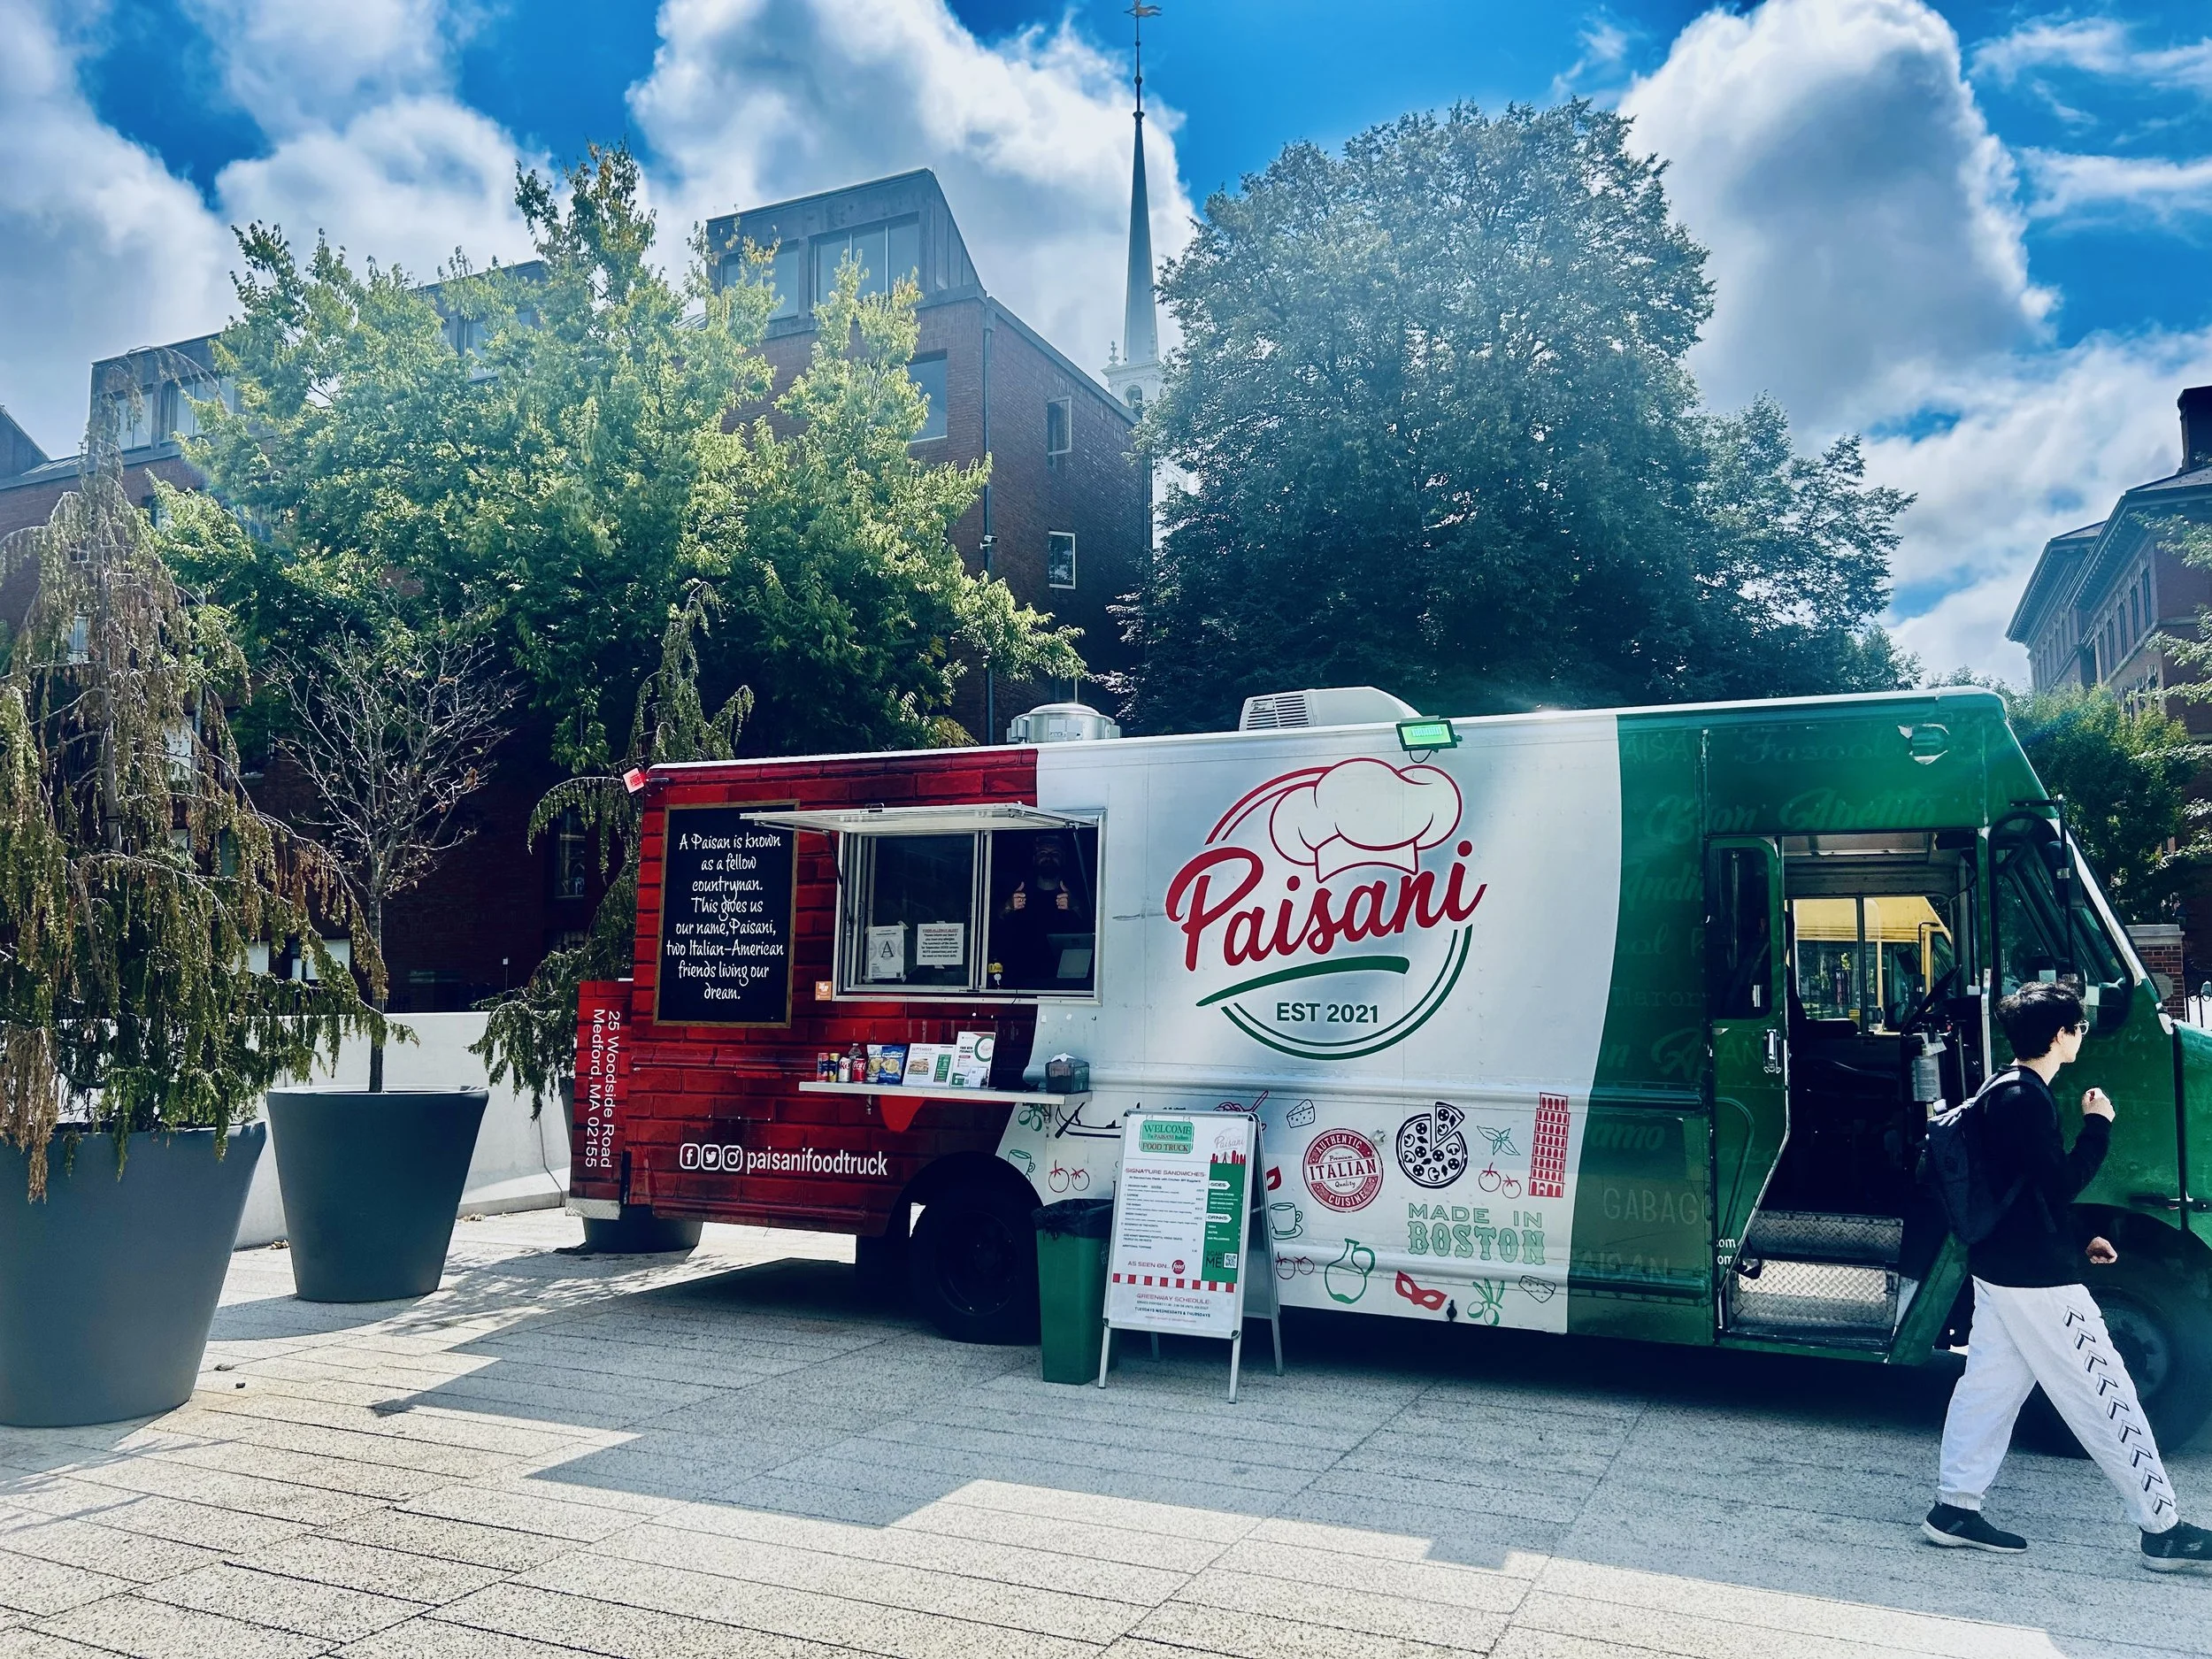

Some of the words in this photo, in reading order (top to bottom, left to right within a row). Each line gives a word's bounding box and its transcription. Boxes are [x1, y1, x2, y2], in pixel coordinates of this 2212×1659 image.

[679, 833, 688, 850] A
[691, 833, 731, 849] Paisan
[733, 833, 742, 849] is
[745, 832, 781, 849] known
[701, 859, 714, 872] as
[716, 858, 724, 871] a
[726, 854, 757, 871] fellow
[692, 879, 764, 904] countryman.
[691, 896, 718, 912] This
[718, 897, 747, 922] gives
[749, 898, 763, 912] us
[1165, 840, 1487, 971] Paisani
[675, 923, 694, 935] our
[729, 918, 777, 937] Paisani,
[666, 941, 687, 956] two
[689, 940, 784, 956] Italian-American
[881, 941, 894, 958] A
[678, 960, 716, 979] friends
[718, 961, 749, 987] living
[750, 964, 769, 979] our
[703, 982, 741, 1000] dream.
[608, 1010, 620, 1031] 25
[1276, 1002, 1320, 1022] EST
[1326, 1003, 1379, 1024] 2021
[590, 1009, 605, 1080] Medford,
[602, 1035, 619, 1118] Woodside
[588, 1085, 601, 1110] MA
[1144, 1125, 1192, 1135] WELCOME
[585, 1117, 600, 1168] 02155
[600, 1125, 615, 1168] Road
[1214, 1135, 1245, 1149] Paisani
[1315, 1134, 1363, 1154] AUTHENTIC
[747, 1146, 888, 1176] paisanifoodtruck
[1310, 1159, 1377, 1180] ITALIAN
[1329, 1192, 1367, 1206] CUISINE
[1409, 1202, 1490, 1224] MADE
[1513, 1211, 1542, 1228] IN
[1408, 1221, 1546, 1265] BOSTON
[1717, 1238, 1736, 1248] om
[1206, 1257, 1222, 1268] ME
